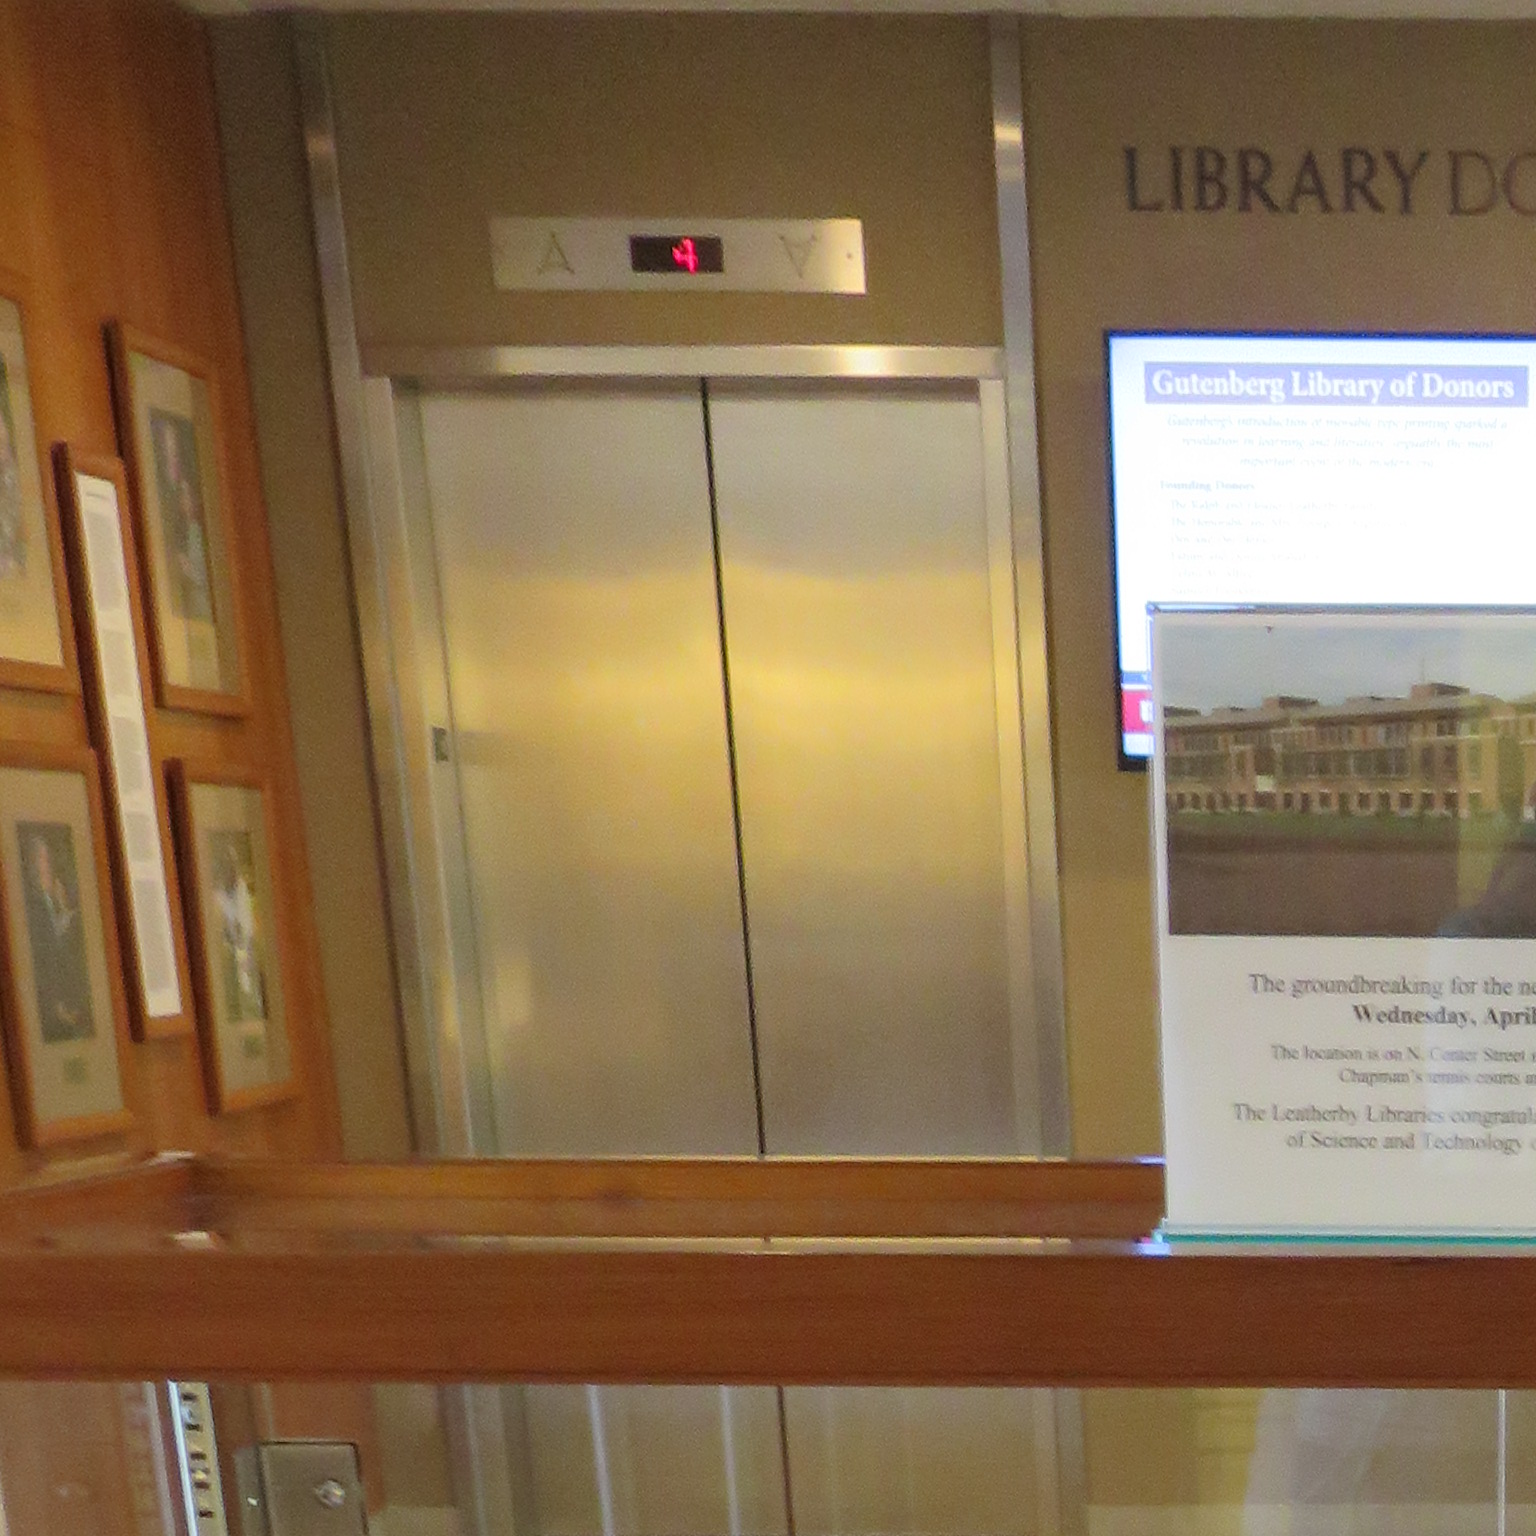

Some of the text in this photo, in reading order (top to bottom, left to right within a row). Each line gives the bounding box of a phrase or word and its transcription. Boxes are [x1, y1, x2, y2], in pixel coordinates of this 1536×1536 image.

[1123, 146, 1429, 214] LIBRARY
[671, 237, 699, 274] 4
[1152, 369, 1514, 404] Gutenberg Library of Donors
[1249, 973, 1285, 994] The
[1292, 975, 1443, 998] groundbreaking
[1451, 976, 1478, 995] for
[1484, 977, 1512, 995] the
[1352, 1003, 1477, 1028] Wednesday,
[1485, 1006, 1536, 1030] April
[1271, 1045, 1299, 1061] The
[1304, 1045, 1363, 1061] location
[1368, 1047, 1380, 1061] is
[1384, 1049, 1401, 1062] on
[1484, 1048, 1525, 1063] Street
[1339, 1068, 1423, 1087] Chapman's
[1475, 1071, 1520, 1085] courts
[1234, 1103, 1266, 1122] The
[1271, 1104, 1358, 1126] Leatherby
[1366, 1105, 1443, 1123] Libraries
[1286, 1131, 1306, 1148] of
[1310, 1131, 1378, 1149] Science
[1383, 1133, 1415, 1149] and
[1423, 1133, 1522, 1155] Technology
